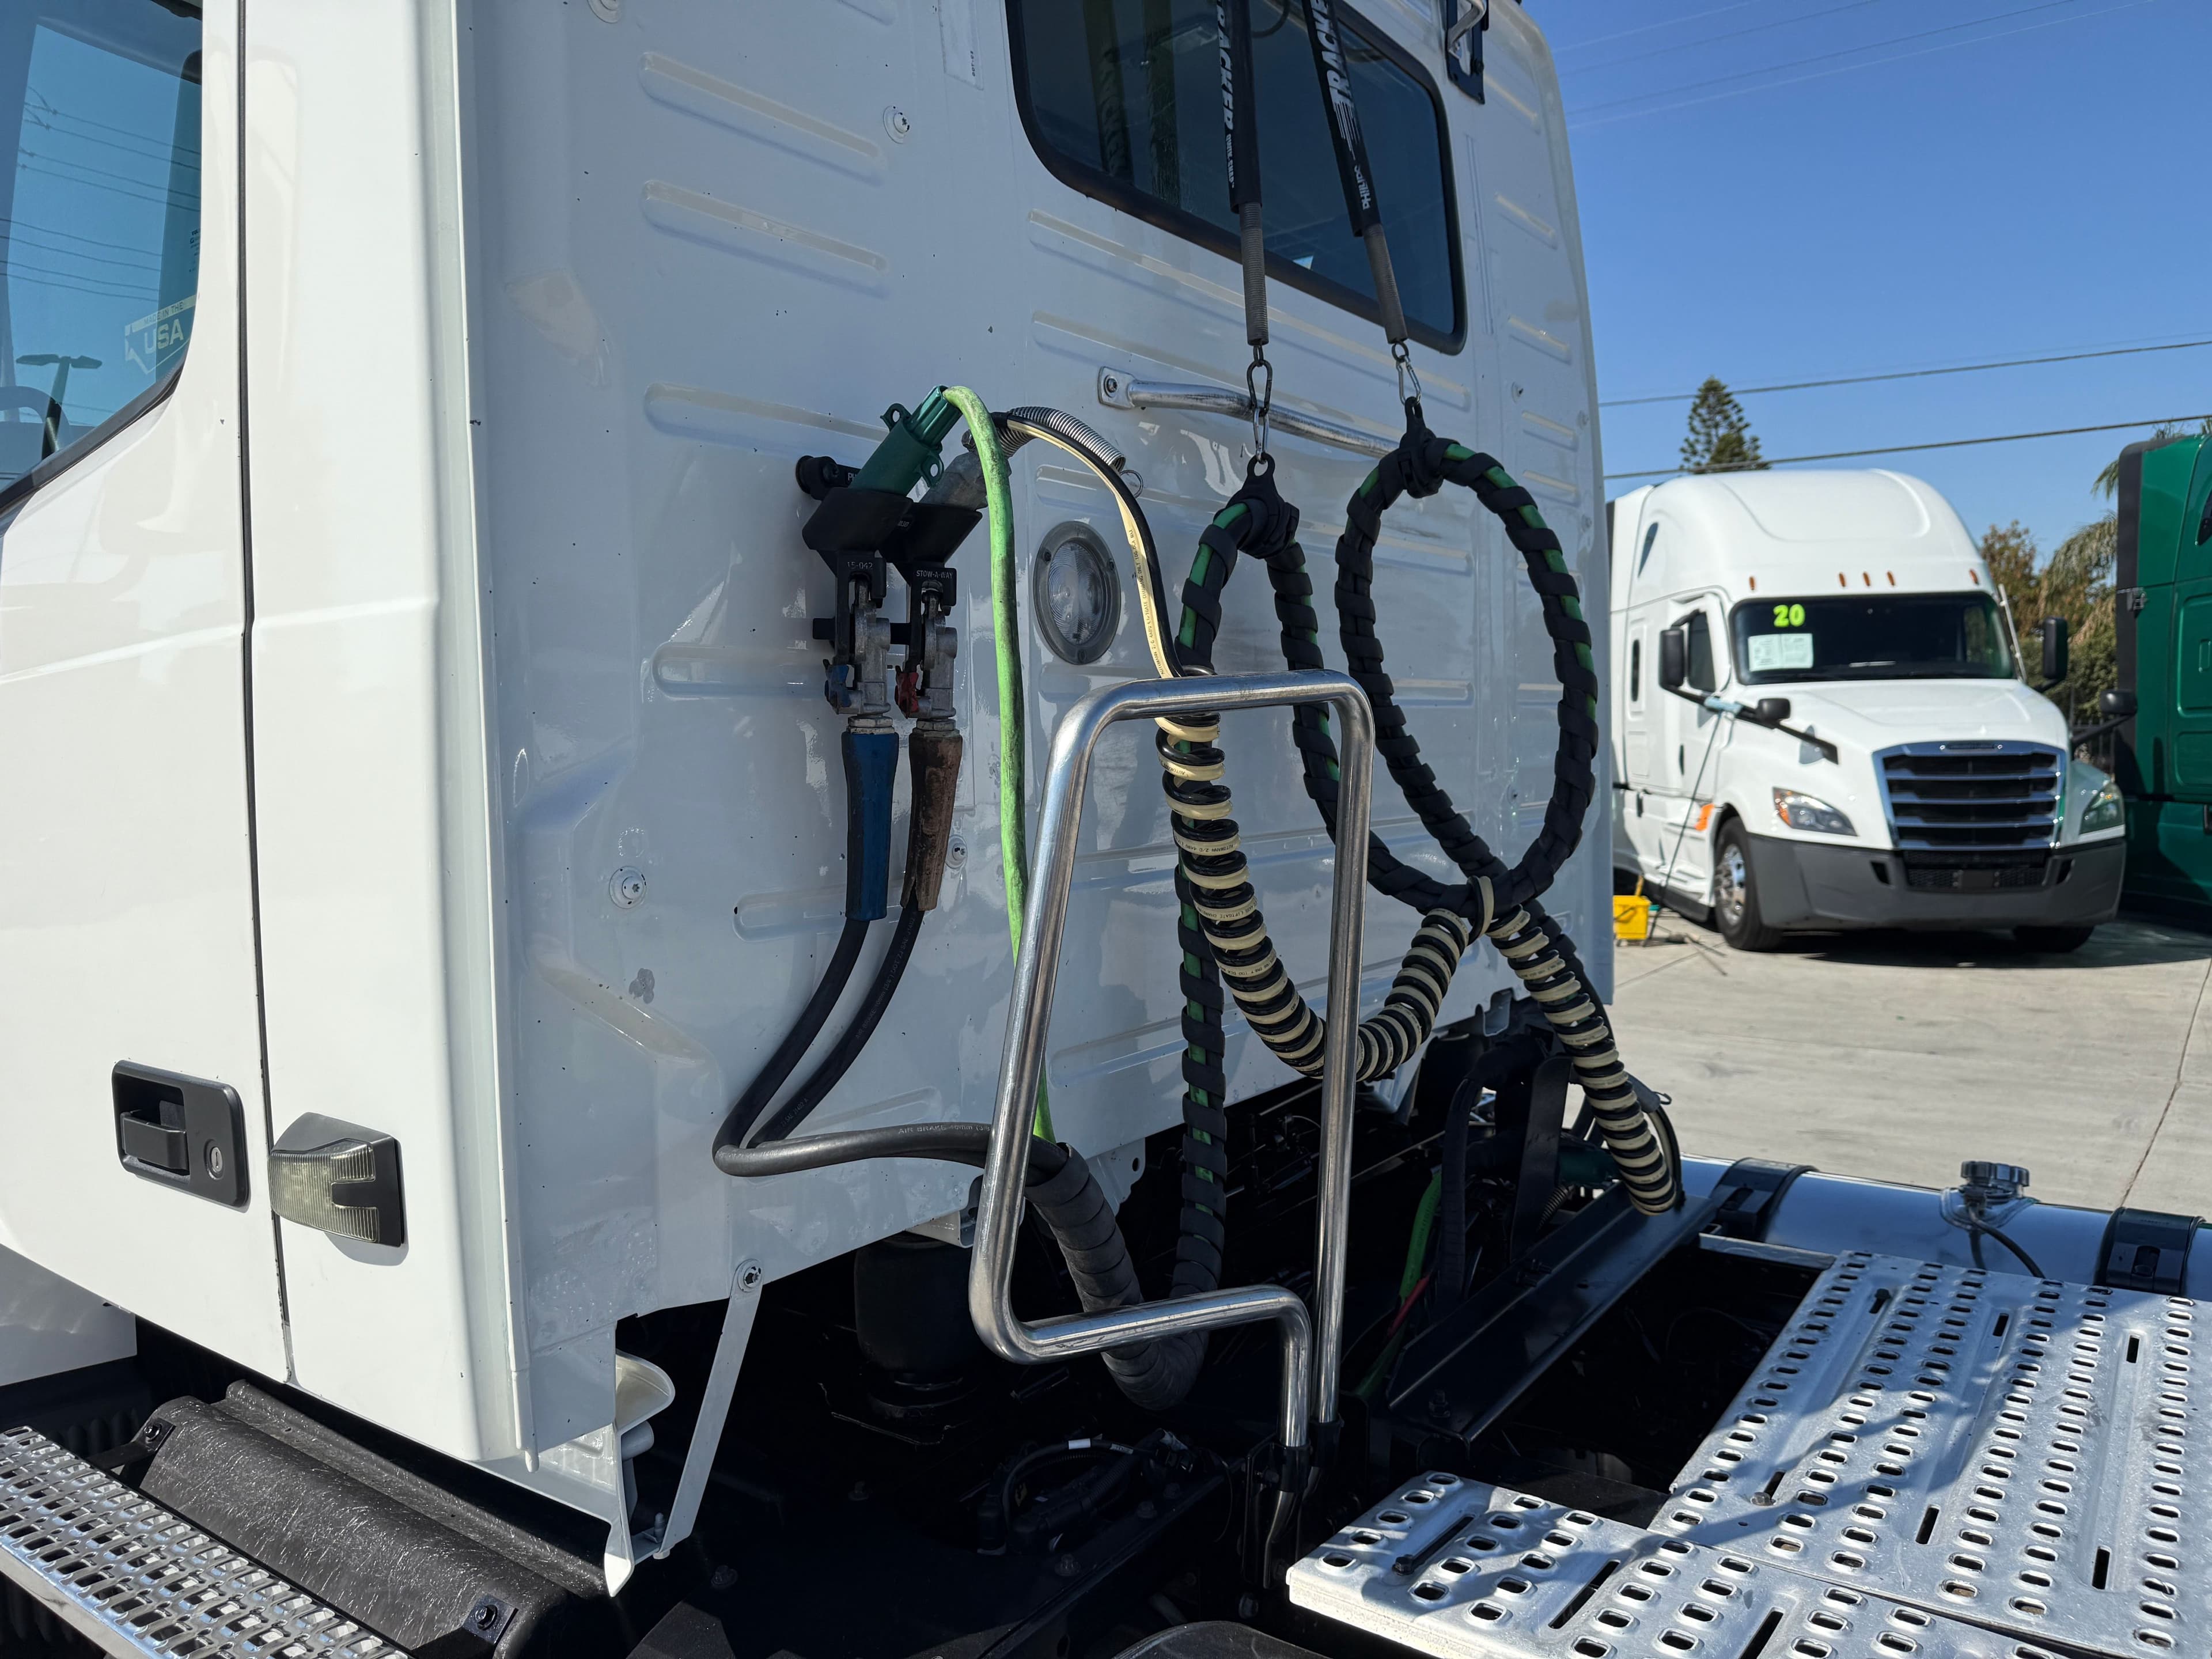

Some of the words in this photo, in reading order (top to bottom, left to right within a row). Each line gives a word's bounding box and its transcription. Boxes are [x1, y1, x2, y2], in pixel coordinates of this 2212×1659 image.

[1216, 0, 1233, 130] RACKER
[172, 301, 184, 313] THE
[144, 319, 184, 354] USA
[916, 570, 953, 579] STOW-A-WAY
[1772, 604, 1805, 627] 20
